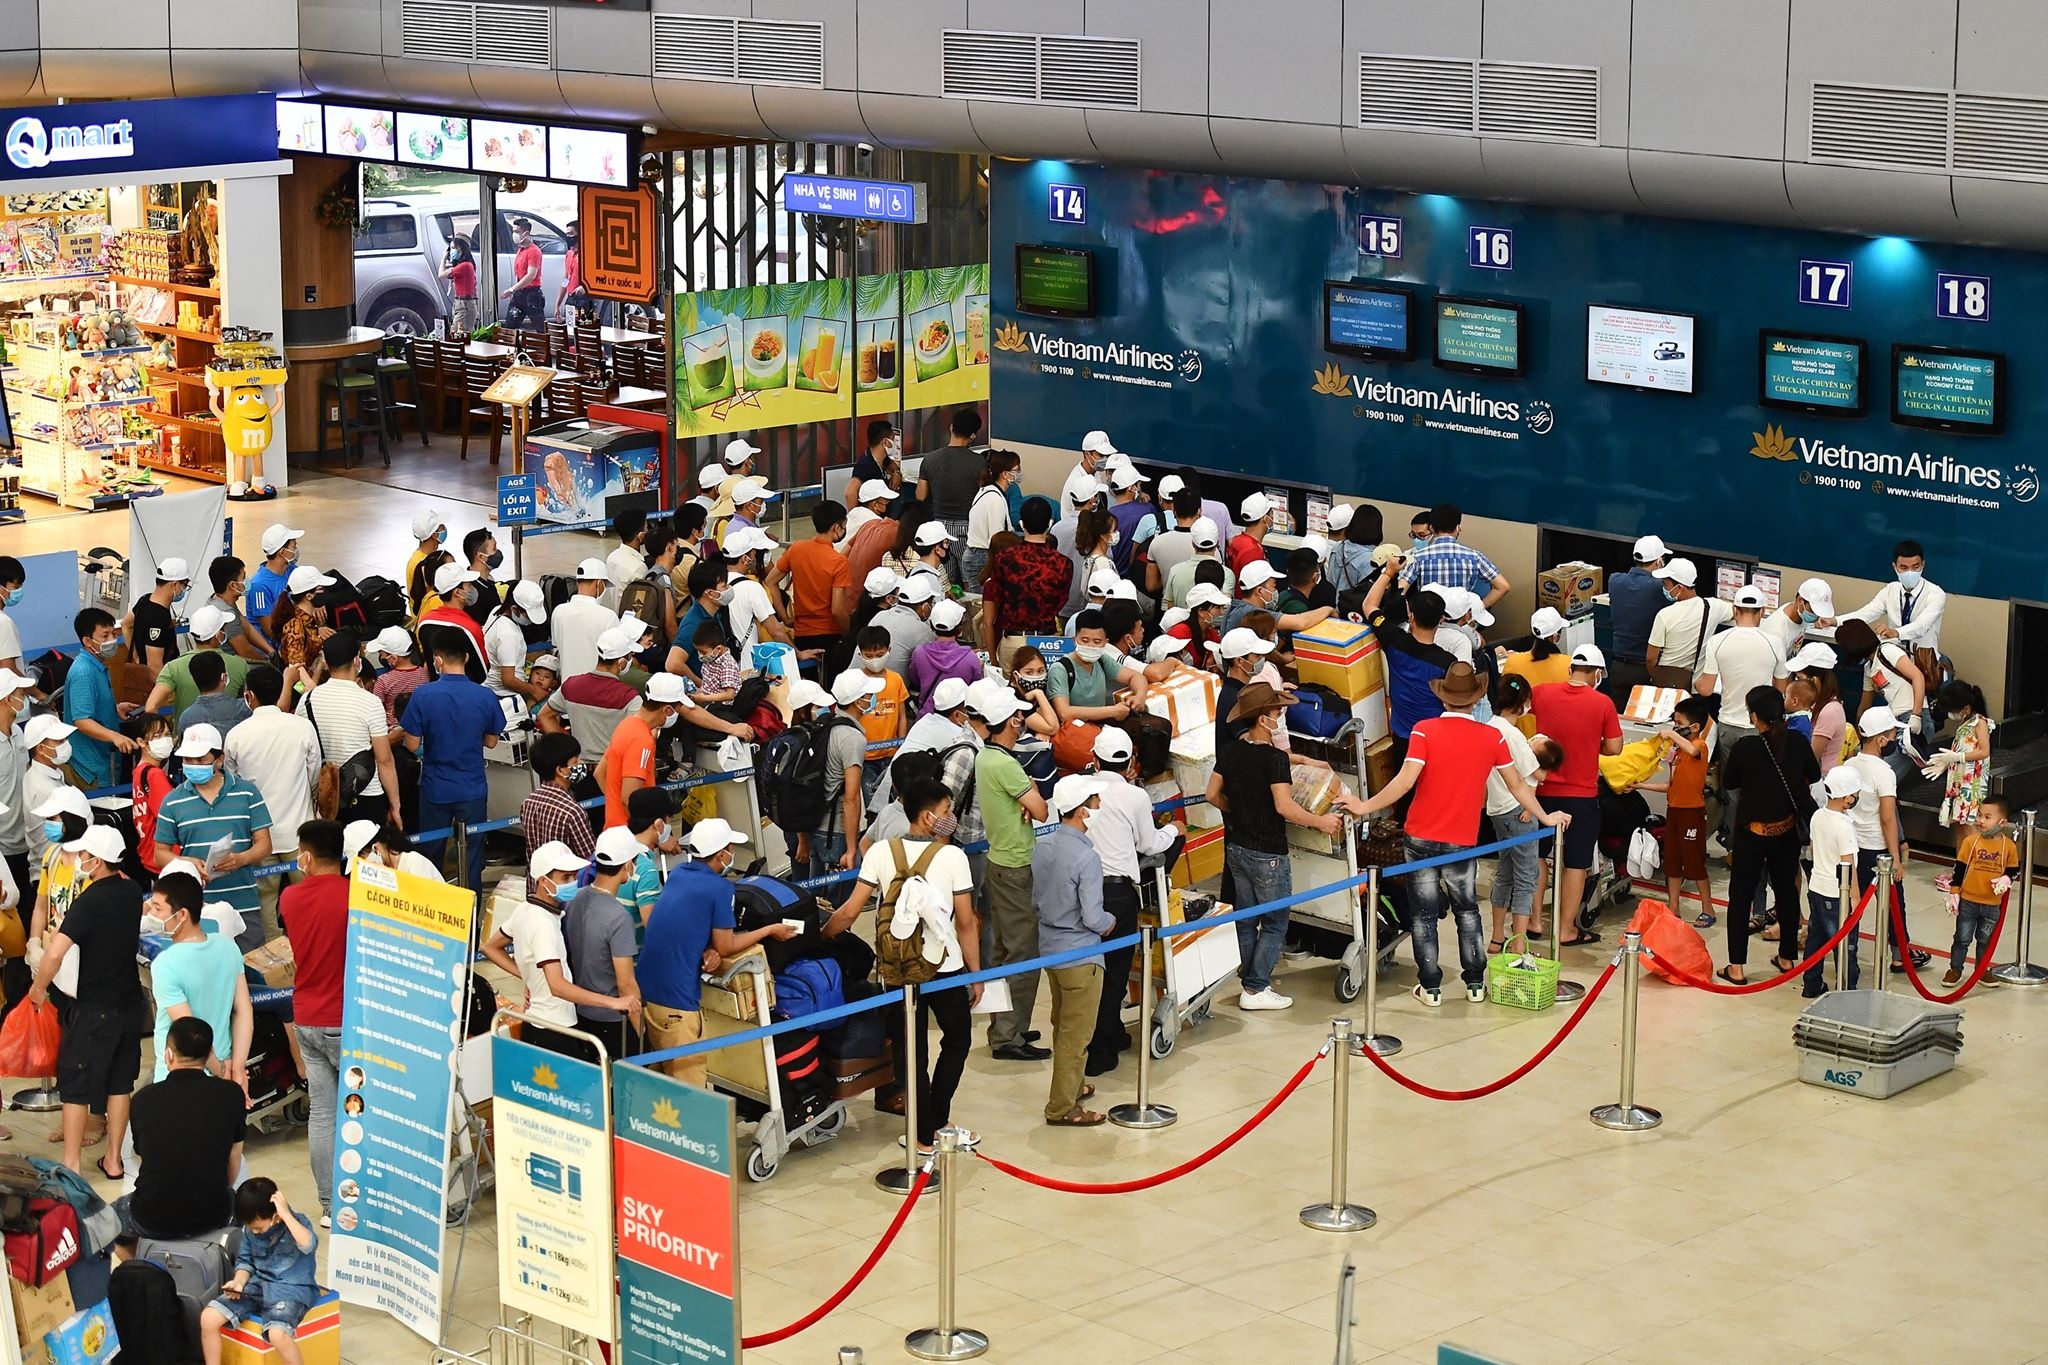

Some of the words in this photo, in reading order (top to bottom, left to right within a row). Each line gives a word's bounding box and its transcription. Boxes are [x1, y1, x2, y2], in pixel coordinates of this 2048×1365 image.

[794, 182, 815, 197] NHÀ
[818, 185, 830, 201] VỆ
[833, 188, 856, 201] SINH
[818, 202, 832, 210] Toilets
[1053, 189, 1082, 219] 14
[1366, 220, 1398, 254] 15
[1476, 232, 1508, 265] 16
[596, 274, 606, 284] PHỞ
[608, 277, 615, 286] LÝ
[617, 278, 631, 287] QUỐC
[634, 280, 641, 289] SƯ
[1806, 266, 1845, 301] 17
[1944, 280, 1985, 316] 18
[1446, 348, 1475, 356] CHECK-IN
[1489, 354, 1514, 362] FLIGHTS
[1040, 364, 1057, 374] 1900
[1059, 366, 1074, 376] 1100
[1093, 372, 1172, 389] www.vietnamairlines.com
[1775, 385, 1806, 394] CHECK-IN
[1821, 391, 1849, 400] FLIGHTS
[1947, 395, 1976, 404] CHUYẾN
[1906, 401, 1940, 410] CHECK-IN
[1958, 407, 1989, 416] FLIGHTS
[1365, 409, 1384, 420] 1900
[1386, 412, 1404, 423] 1100
[1425, 419, 1518, 440] www.vietnamairlines.com
[1799, 438, 1902, 476] Vietnam
[1904, 452, 2000, 489] Airlines
[508, 477, 526, 487] AGS
[503, 494, 517, 505] LỐI
[1814, 475, 1837, 487] 1900
[1839, 478, 1861, 490] 1100
[1887, 486, 1999, 509] www.vietnamairlines.com
[507, 507, 527, 516] EXIT
[1039, 640, 1064, 649] AGS
[685, 779, 704, 787] VIETNAM
[1184, 796, 1196, 805] CẢNG
[1037, 826, 1049, 835] QUỐC
[269, 864, 290, 873] VIETNAM
[362, 865, 378, 878] ACV
[809, 879, 814, 887] TẾ
[367, 890, 390, 905] CÁCH
[393, 897, 409, 912] ĐEO
[412, 903, 435, 919] KHẨU
[438, 911, 465, 929] TRANG
[254, 993, 271, 1002] HÀNG
[272, 989, 293, 999] KHÔNG
[1824, 1069, 1862, 1087] AGS
[623, 1196, 664, 1227] SKY
[624, 1218, 719, 1271] PRIORITY
[46, 1244, 77, 1270] adidas
[336, 1270, 352, 1282] Mong
[354, 1274, 365, 1285] quý
[657, 1307, 674, 1320] Class
[671, 1340, 684, 1352] Plus
[684, 1345, 709, 1362] Member
[712, 1345, 726, 1358] Plus
